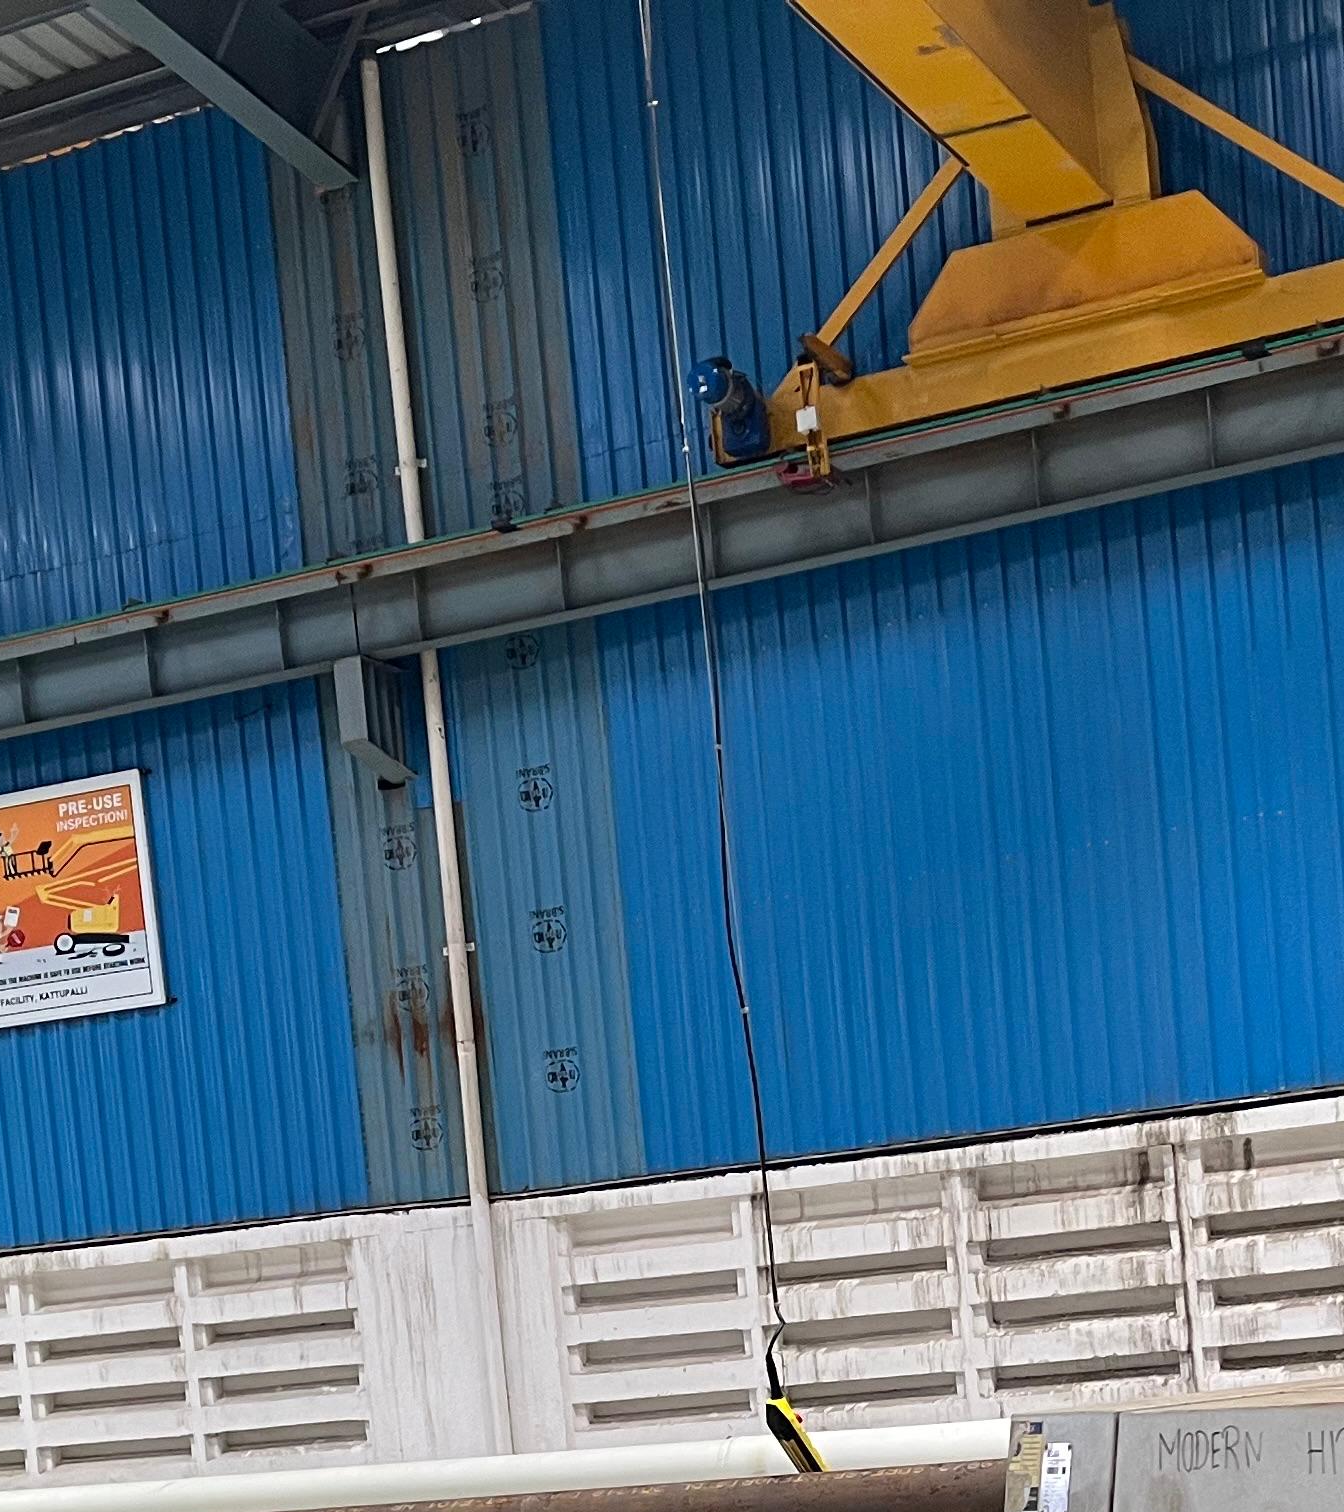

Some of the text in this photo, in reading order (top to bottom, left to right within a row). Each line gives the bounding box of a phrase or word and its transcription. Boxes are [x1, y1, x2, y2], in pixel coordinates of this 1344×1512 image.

[58, 793, 122, 817] PRE-USE
[56, 809, 128, 832] INSPECTION!
[39, 986, 88, 1001] KATTUPALLI
[1158, 1425, 1264, 1473] MODERN
